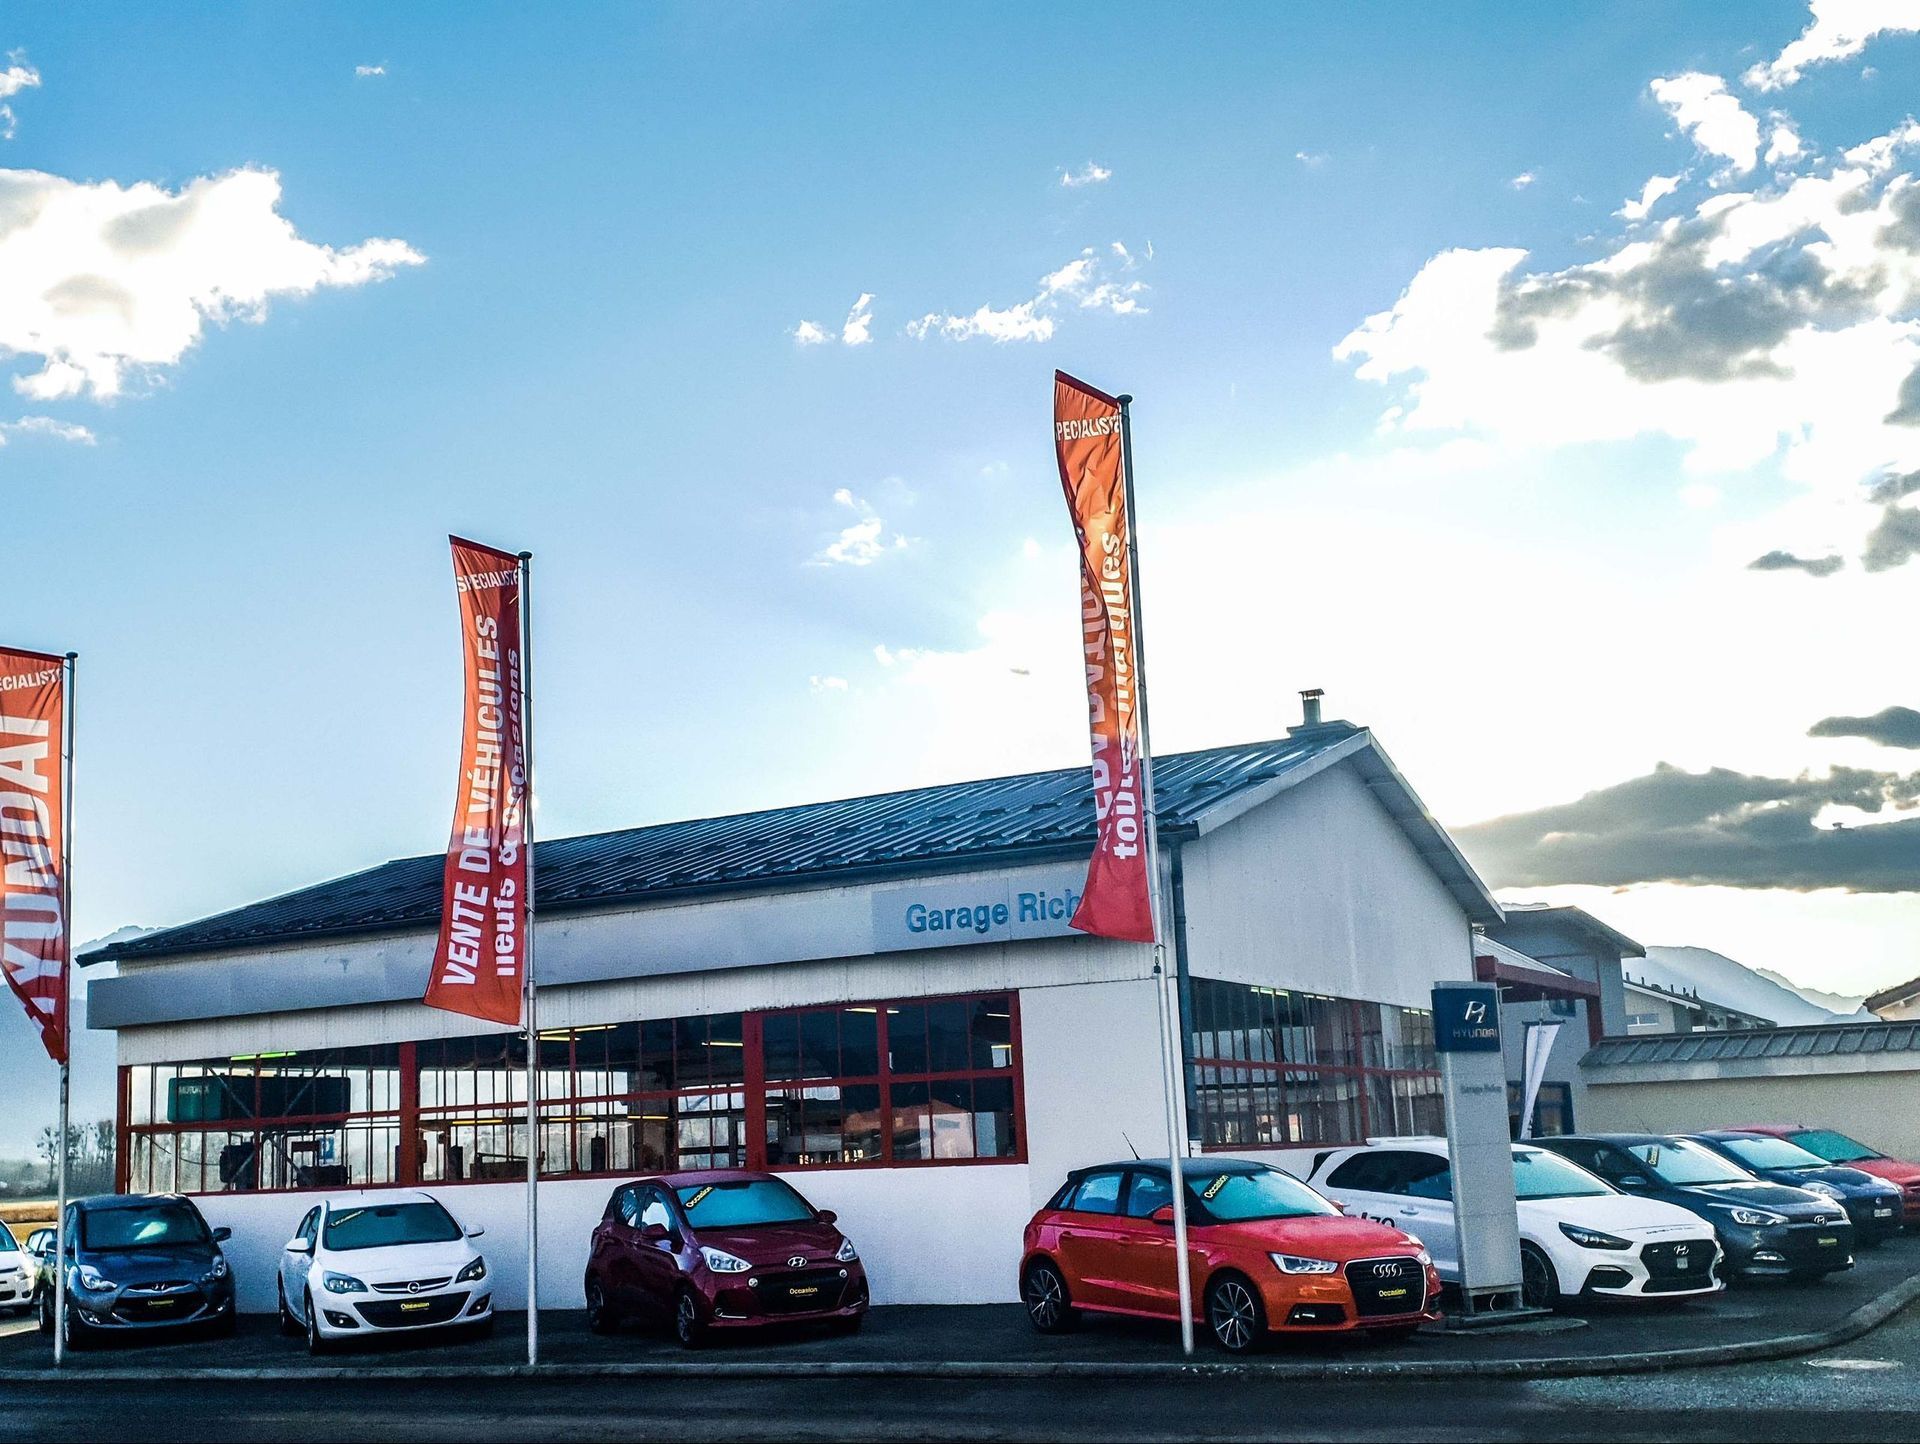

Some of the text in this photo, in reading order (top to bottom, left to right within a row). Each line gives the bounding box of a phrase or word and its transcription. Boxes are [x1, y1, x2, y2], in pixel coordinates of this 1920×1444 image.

[441, 614, 504, 985] VENTE DE VÉHICULES
[498, 838, 518, 867] &
[905, 888, 1080, 934] Garage Rich
[1452, 1028, 1498, 1038] HYUNDAI
[685, 1186, 713, 1208] Occasion
[1203, 1174, 1229, 1199] Occasion
[789, 1286, 818, 1295] Occasion
[1378, 1288, 1407, 1297] Occasion
